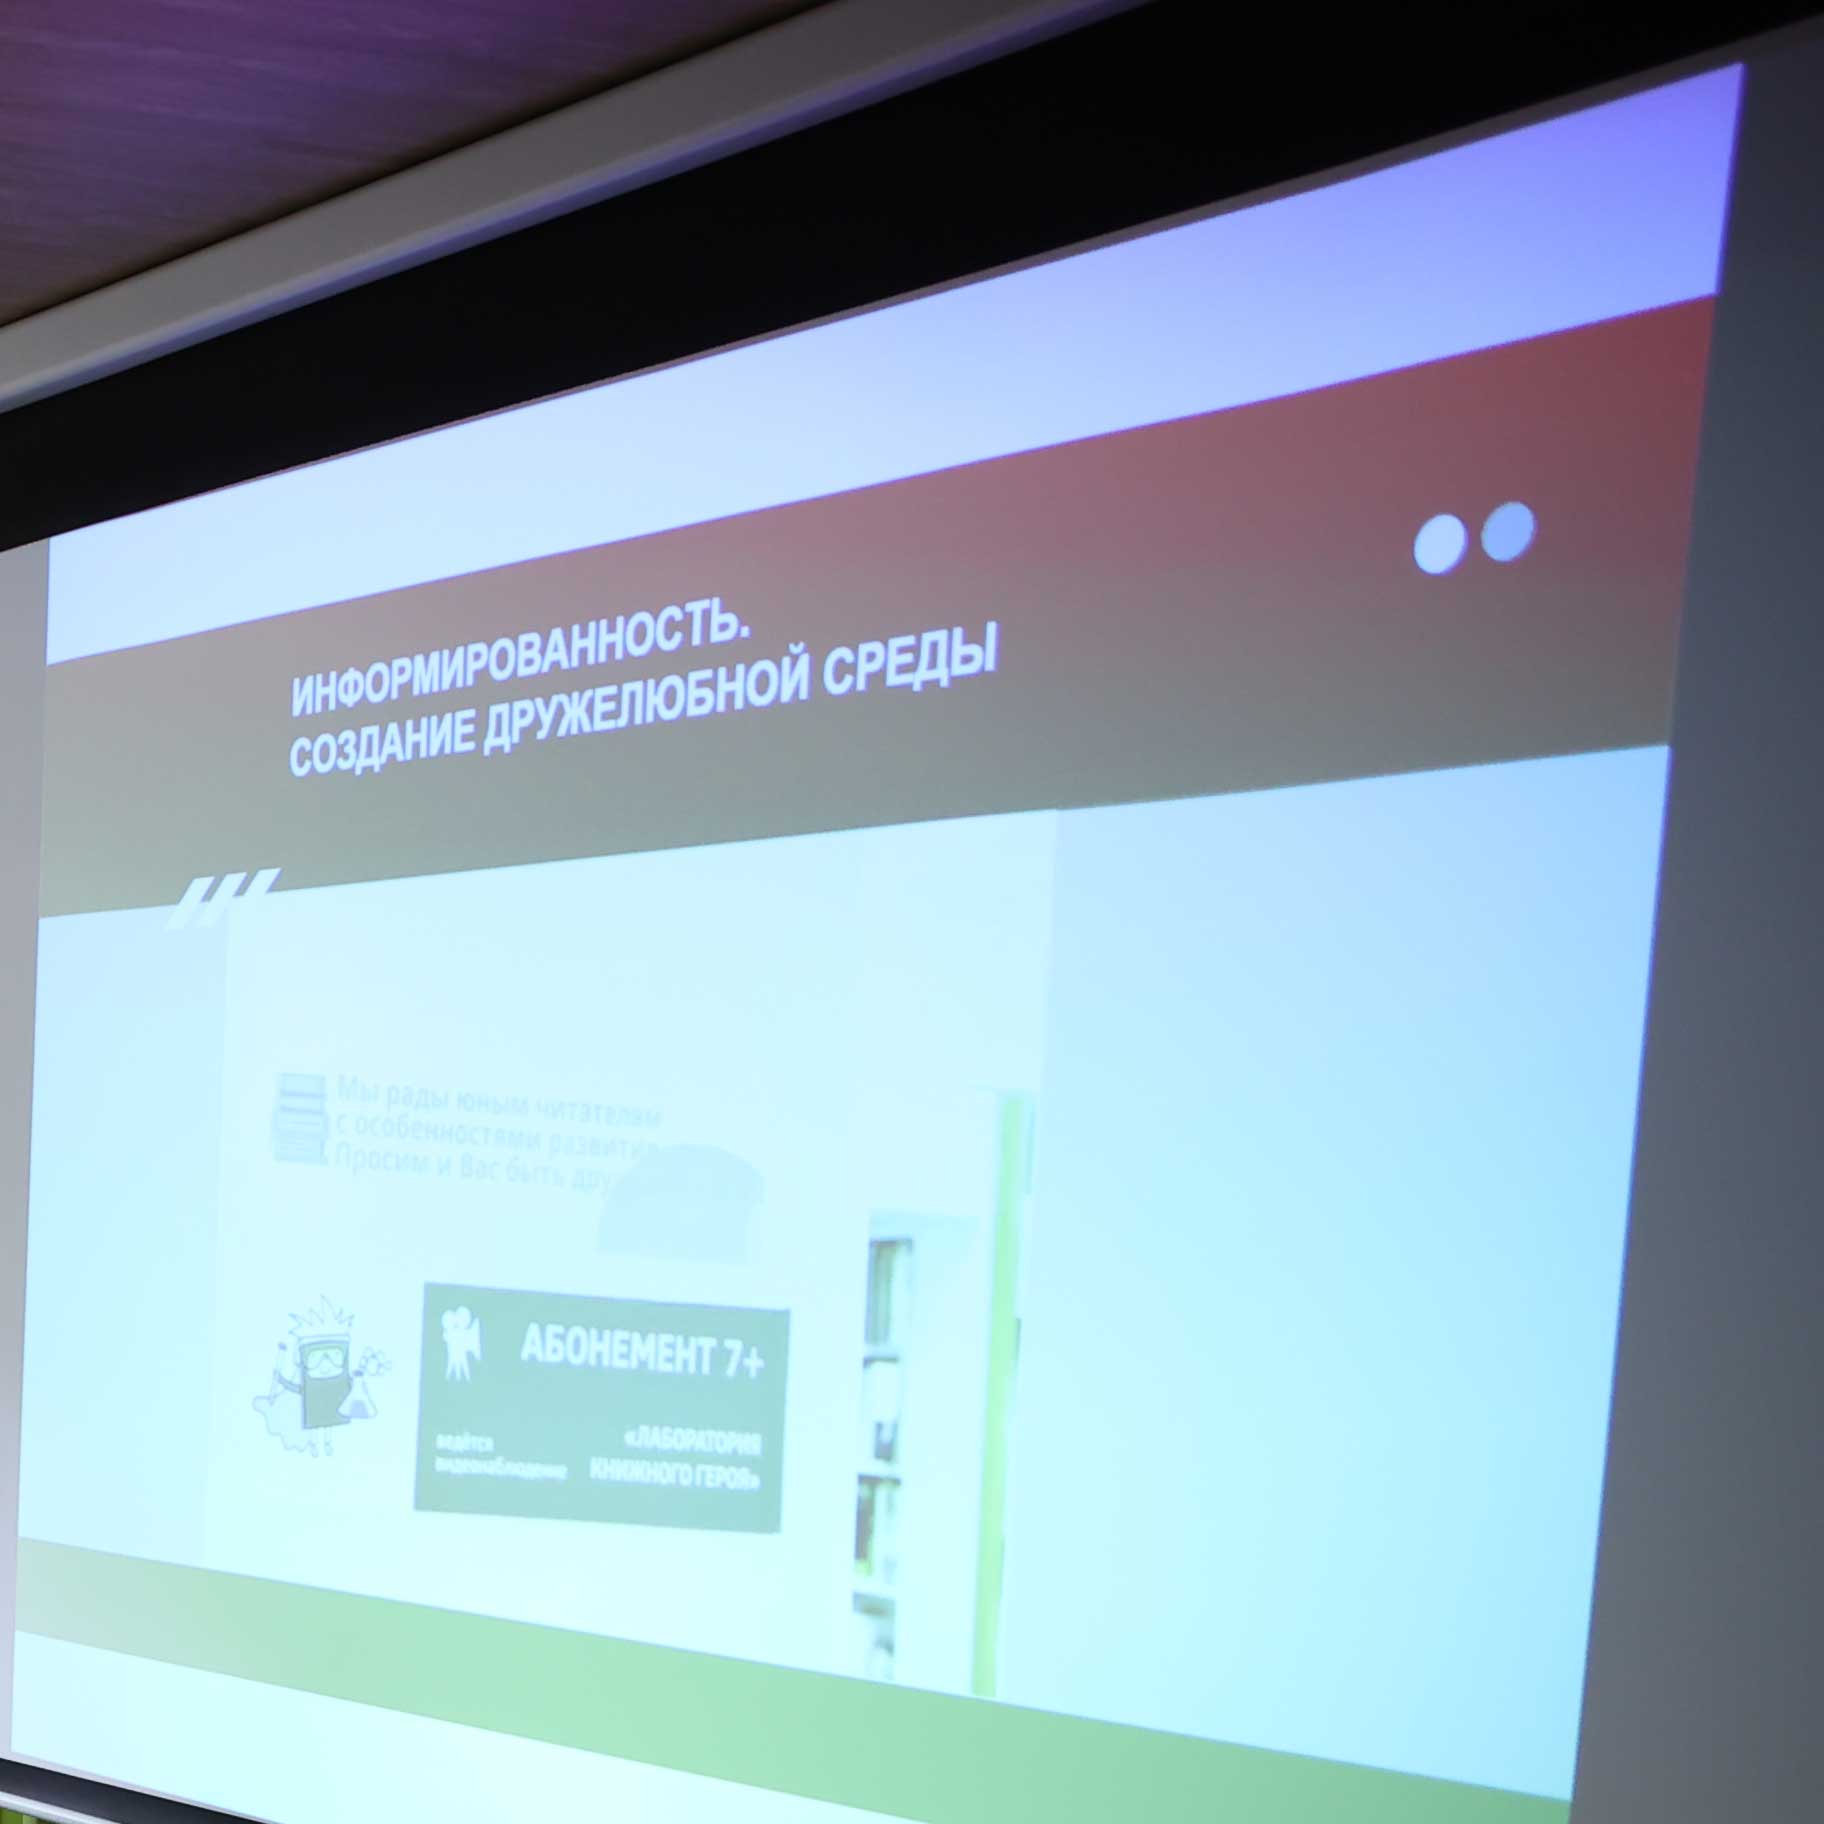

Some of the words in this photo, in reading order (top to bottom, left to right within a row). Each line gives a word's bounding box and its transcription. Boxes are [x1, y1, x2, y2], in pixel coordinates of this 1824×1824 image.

[289, 709, 476, 778] СОЗДАНИЕ
[483, 643, 810, 756] ДРУЖЕЛЮБНОЙ
[823, 621, 999, 697] СРЕДЫ
[291, 597, 750, 717] ИНФОРМИРОВАННОСТЬ.
[520, 1321, 717, 1376] АБОНЕМЕНТ
[723, 1338, 765, 1379] 7+
[589, 1456, 692, 1488] КНИЖНОГО
